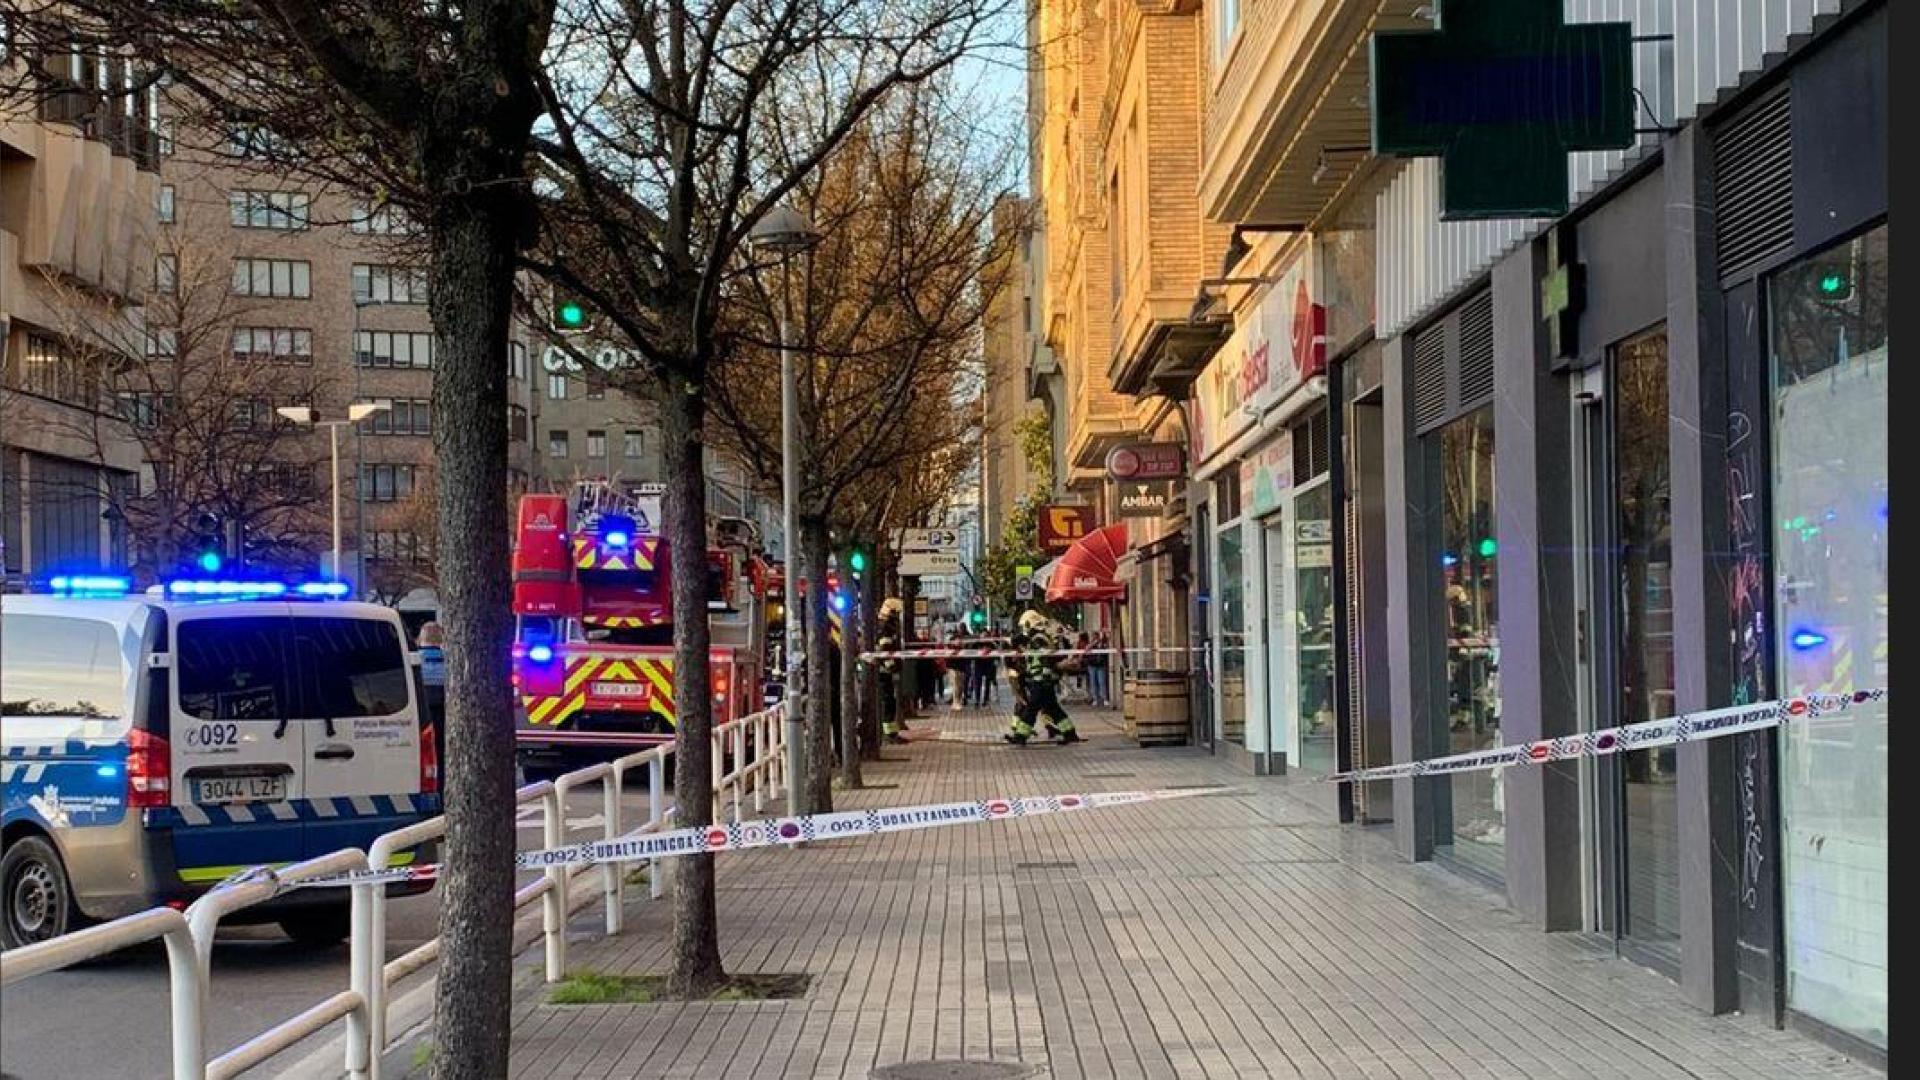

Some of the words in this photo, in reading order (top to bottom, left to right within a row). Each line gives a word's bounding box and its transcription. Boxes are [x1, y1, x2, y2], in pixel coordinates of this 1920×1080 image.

[1121, 495, 1164, 507] AMBAR
[200, 724, 238, 746] 092
[203, 781, 244, 799] 3044
[250, 779, 280, 798] LZF
[830, 819, 864, 833] 092
[882, 806, 978, 827] UDALTZAINGOA
[543, 849, 578, 864] 092
[596, 835, 694, 859] UDALTZAINGOA
